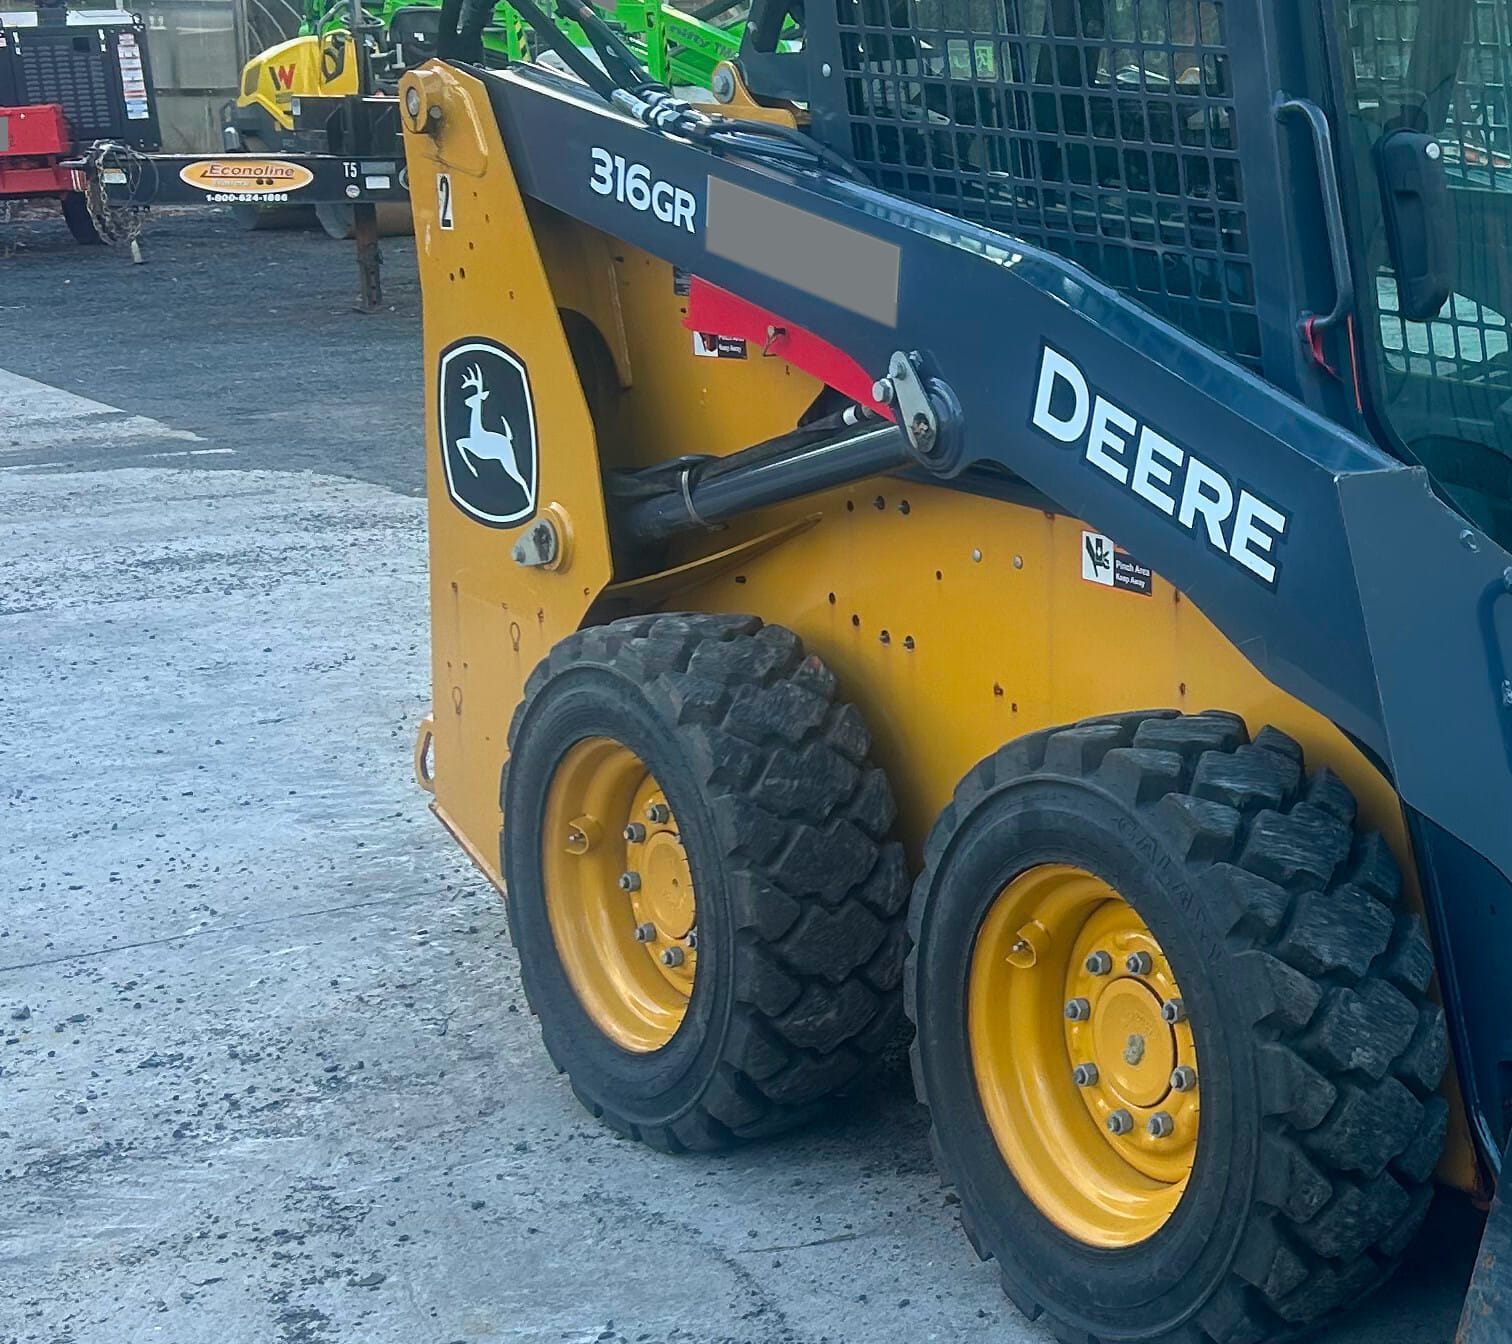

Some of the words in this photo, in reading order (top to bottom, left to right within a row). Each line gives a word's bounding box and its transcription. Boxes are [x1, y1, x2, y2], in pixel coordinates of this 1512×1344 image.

[209, 164, 295, 177] Econoline
[342, 161, 357, 178] T5
[589, 146, 697, 234] 316GR
[439, 175, 452, 228] 2
[1032, 345, 1286, 584] DEERE
